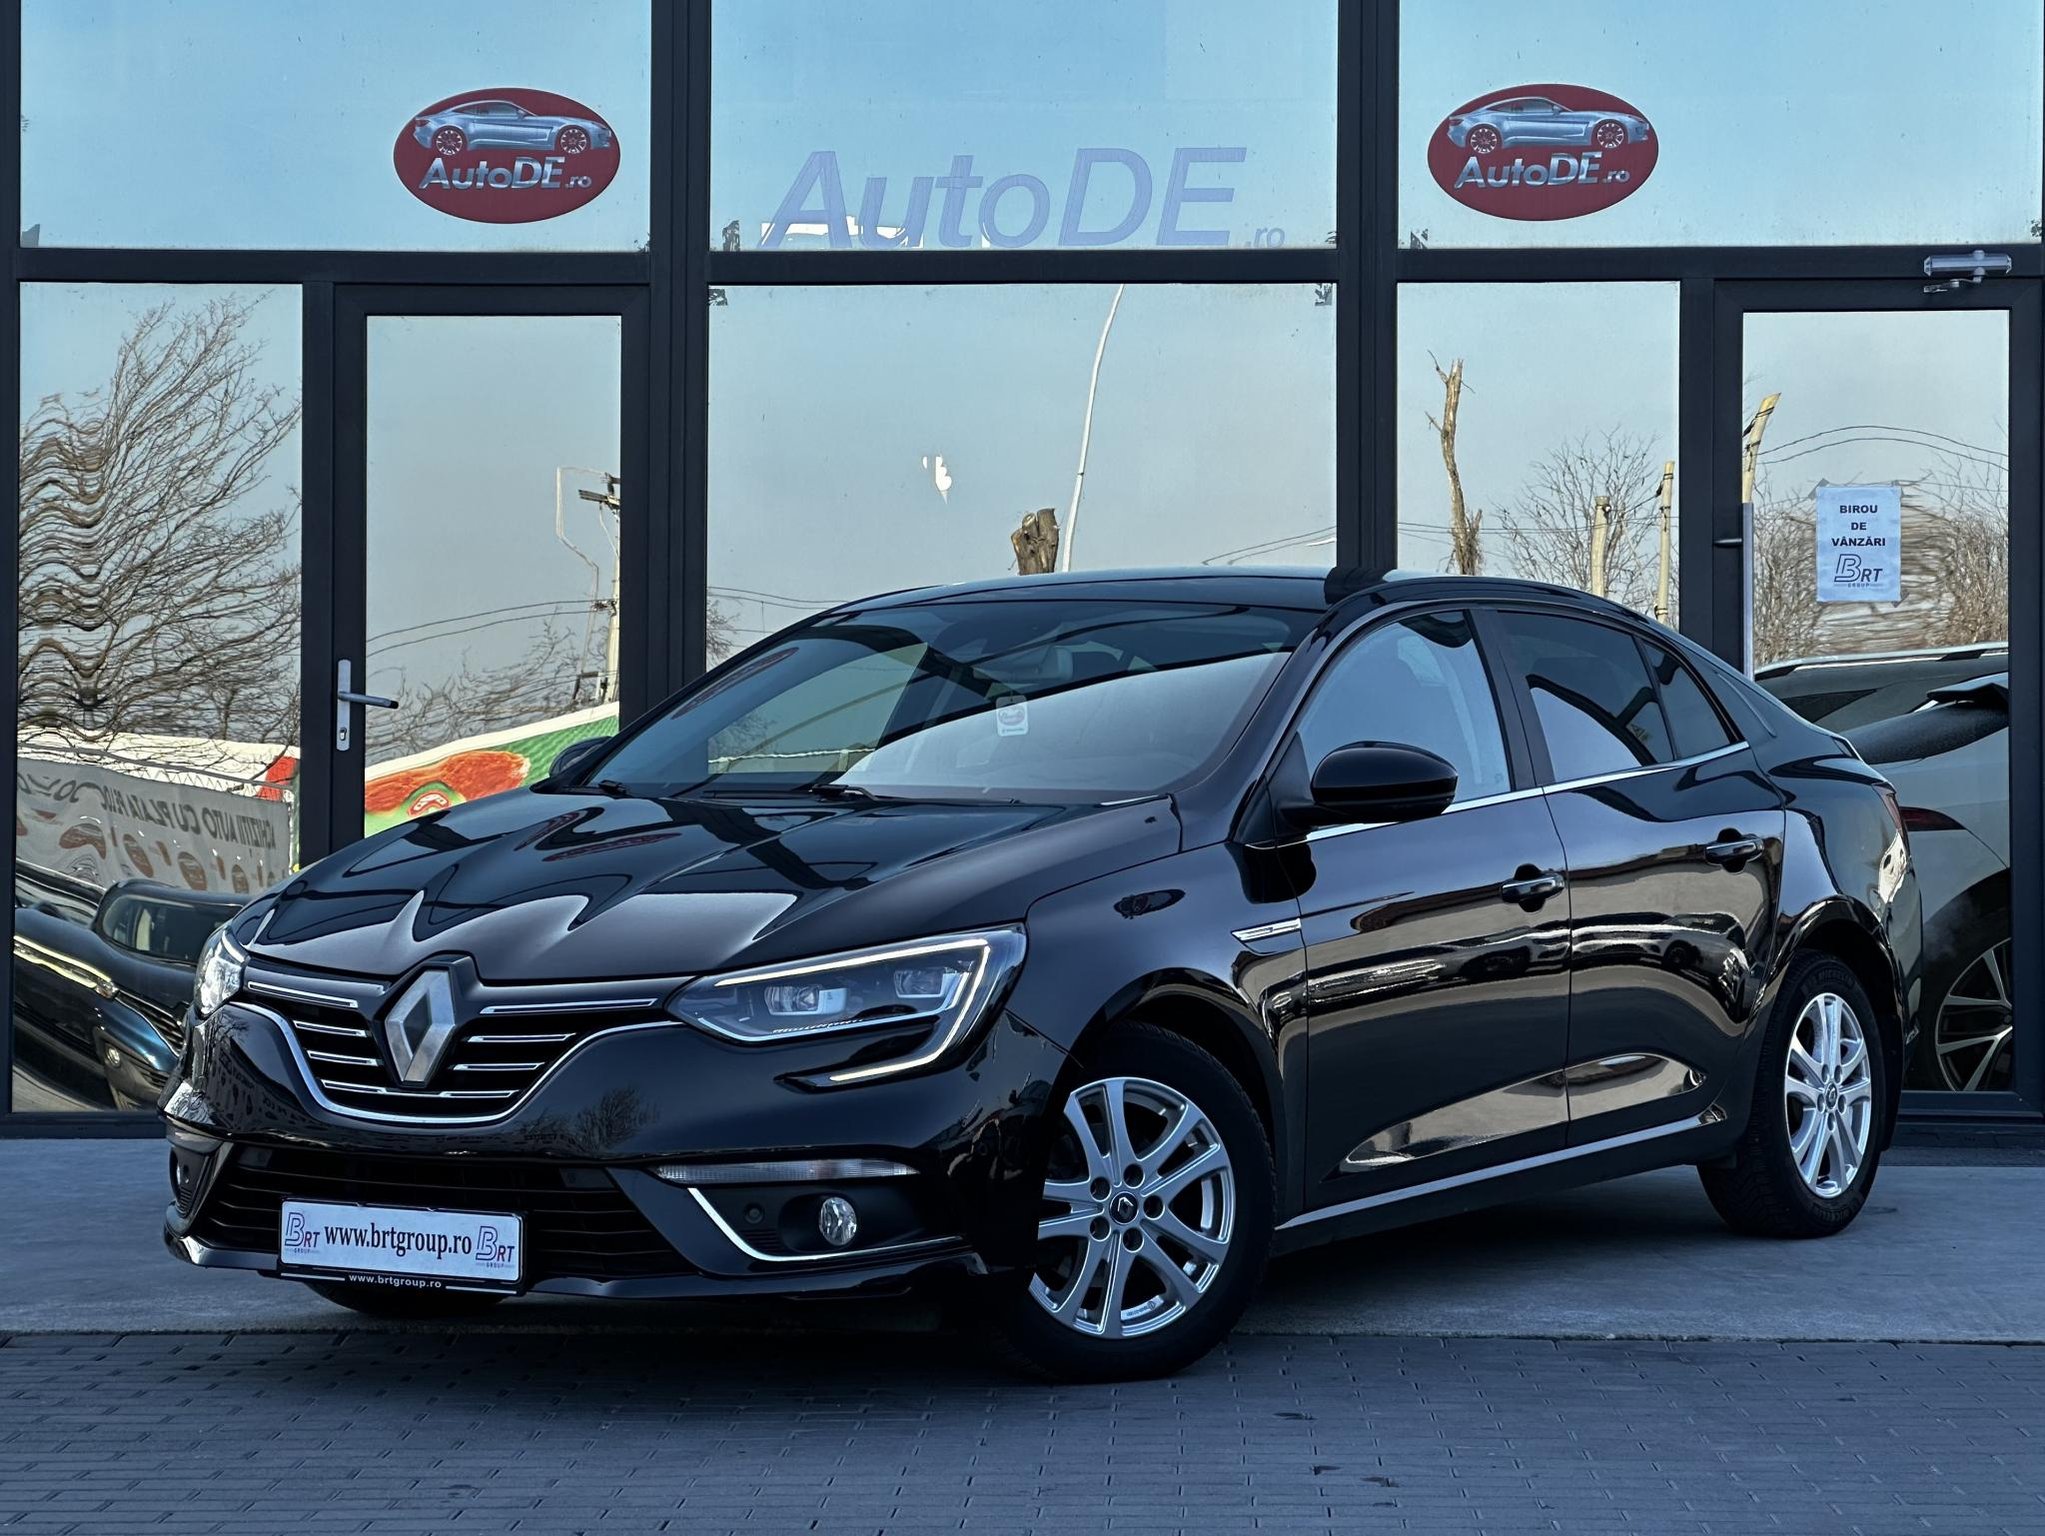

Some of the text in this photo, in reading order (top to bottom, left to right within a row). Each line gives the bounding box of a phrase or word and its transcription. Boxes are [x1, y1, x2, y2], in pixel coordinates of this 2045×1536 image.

[1839, 505, 1878, 514] BIROU
[1850, 522, 1867, 531] DE
[1831, 536, 1886, 547] VÂNZĂRI
[284, 1212, 515, 1263] BRT www.brtgroup.ro BRT
[349, 1274, 441, 1289] www.brtgroup.ro
